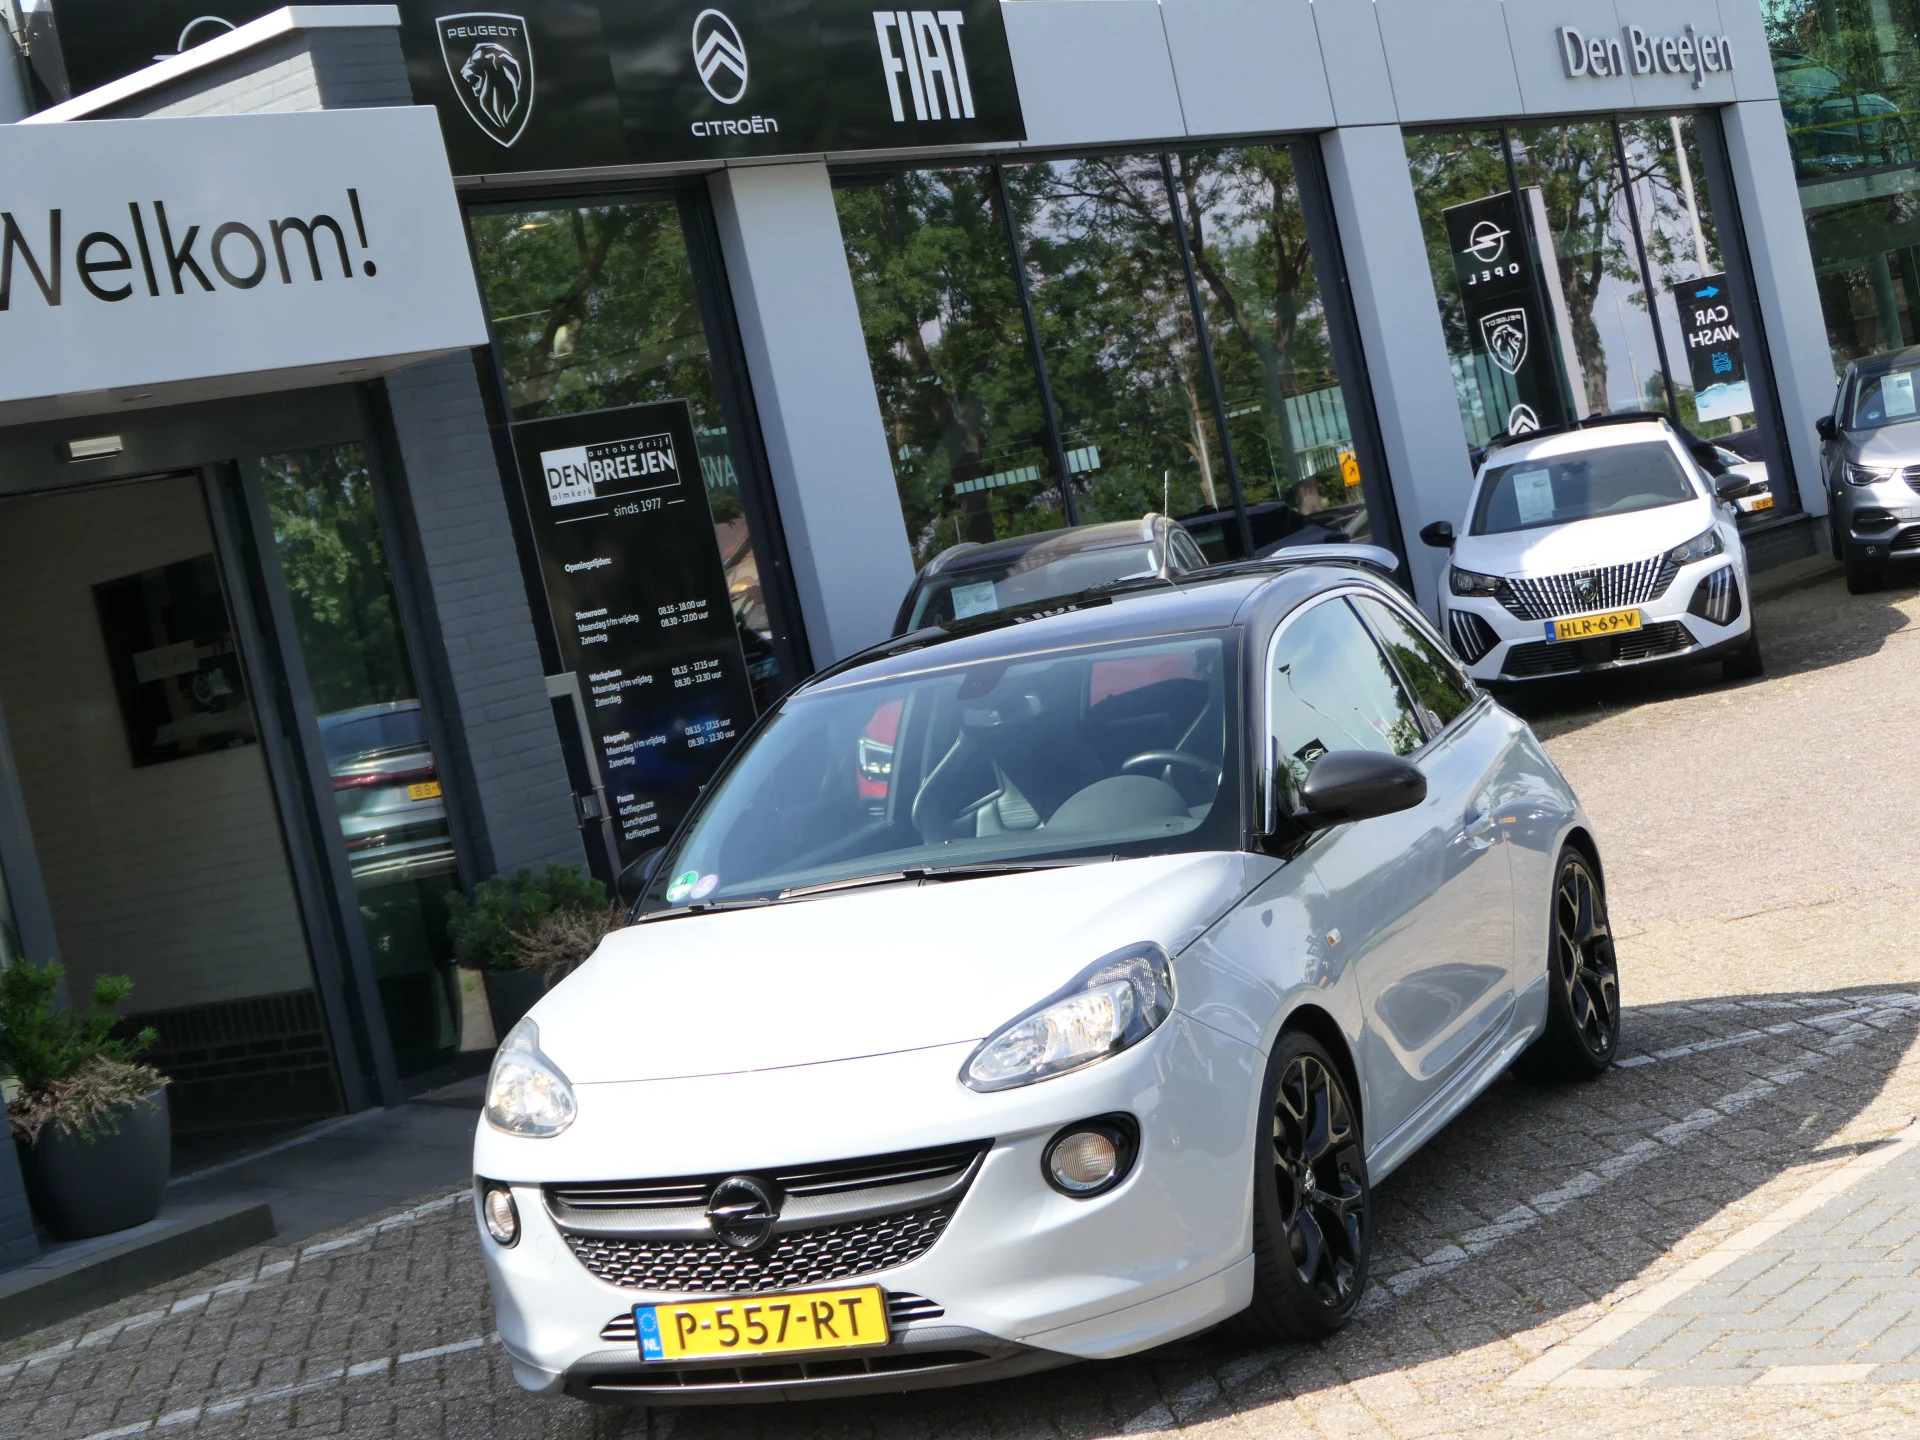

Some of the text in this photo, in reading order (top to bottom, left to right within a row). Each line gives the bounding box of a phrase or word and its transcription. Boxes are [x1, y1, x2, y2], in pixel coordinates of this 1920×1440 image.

[447, 25, 518, 39] PEUGEOT
[1555, 22, 1735, 90] Den Breejen
[872, 11, 975, 122] FIAT
[691, 116, 778, 137] CITROËN
[0, 188, 377, 311] Welkom!
[588, 437, 670, 457] autobedrijf
[547, 449, 675, 489] DEN BREEJEN
[552, 487, 593, 501] almkerk
[614, 498, 661, 517] sinds 1977
[564, 557, 612, 573] Openingstijden:
[575, 608, 608, 620] Showroom
[578, 621, 607, 632] Maandag
[618, 614, 639, 624] vrijdag
[658, 605, 675, 615] 08.15
[678, 601, 696, 611] 18.00
[580, 634, 608, 645] Zaterdag
[661, 617, 678, 627] 08.30
[682, 613, 698, 623] 17.00
[698, 611, 709, 619] uur
[1560, 613, 1634, 637] HLR-69-V
[589, 669, 622, 682] Werkplaats
[592, 682, 620, 695] Maandag
[631, 675, 653, 686] vrijdag
[671, 665, 688, 675] 08.15
[693, 661, 708, 671] 17.15
[595, 695, 622, 707] Zaterdag
[674, 677, 691, 687] 08.30
[711, 671, 722, 679] uur
[603, 731, 630, 744] Magazijn
[606, 743, 634, 756] Maandag
[645, 735, 667, 746] vrijdag
[685, 725, 702, 735] 08.15
[705, 720, 720, 730] 17.15
[608, 756, 635, 769] Zaterdag
[688, 736, 705, 748] 08.30
[708, 731, 725, 742] 12.30
[725, 730, 735, 738] uur
[617, 794, 635, 804] Pauze
[619, 801, 655, 815] Koffiepauze
[622, 813, 657, 828] Lunchpauze
[625, 825, 660, 840] Koffiepauze
[674, 1297, 862, 1350] P-557-RT
[643, 1339, 661, 1351] NL
